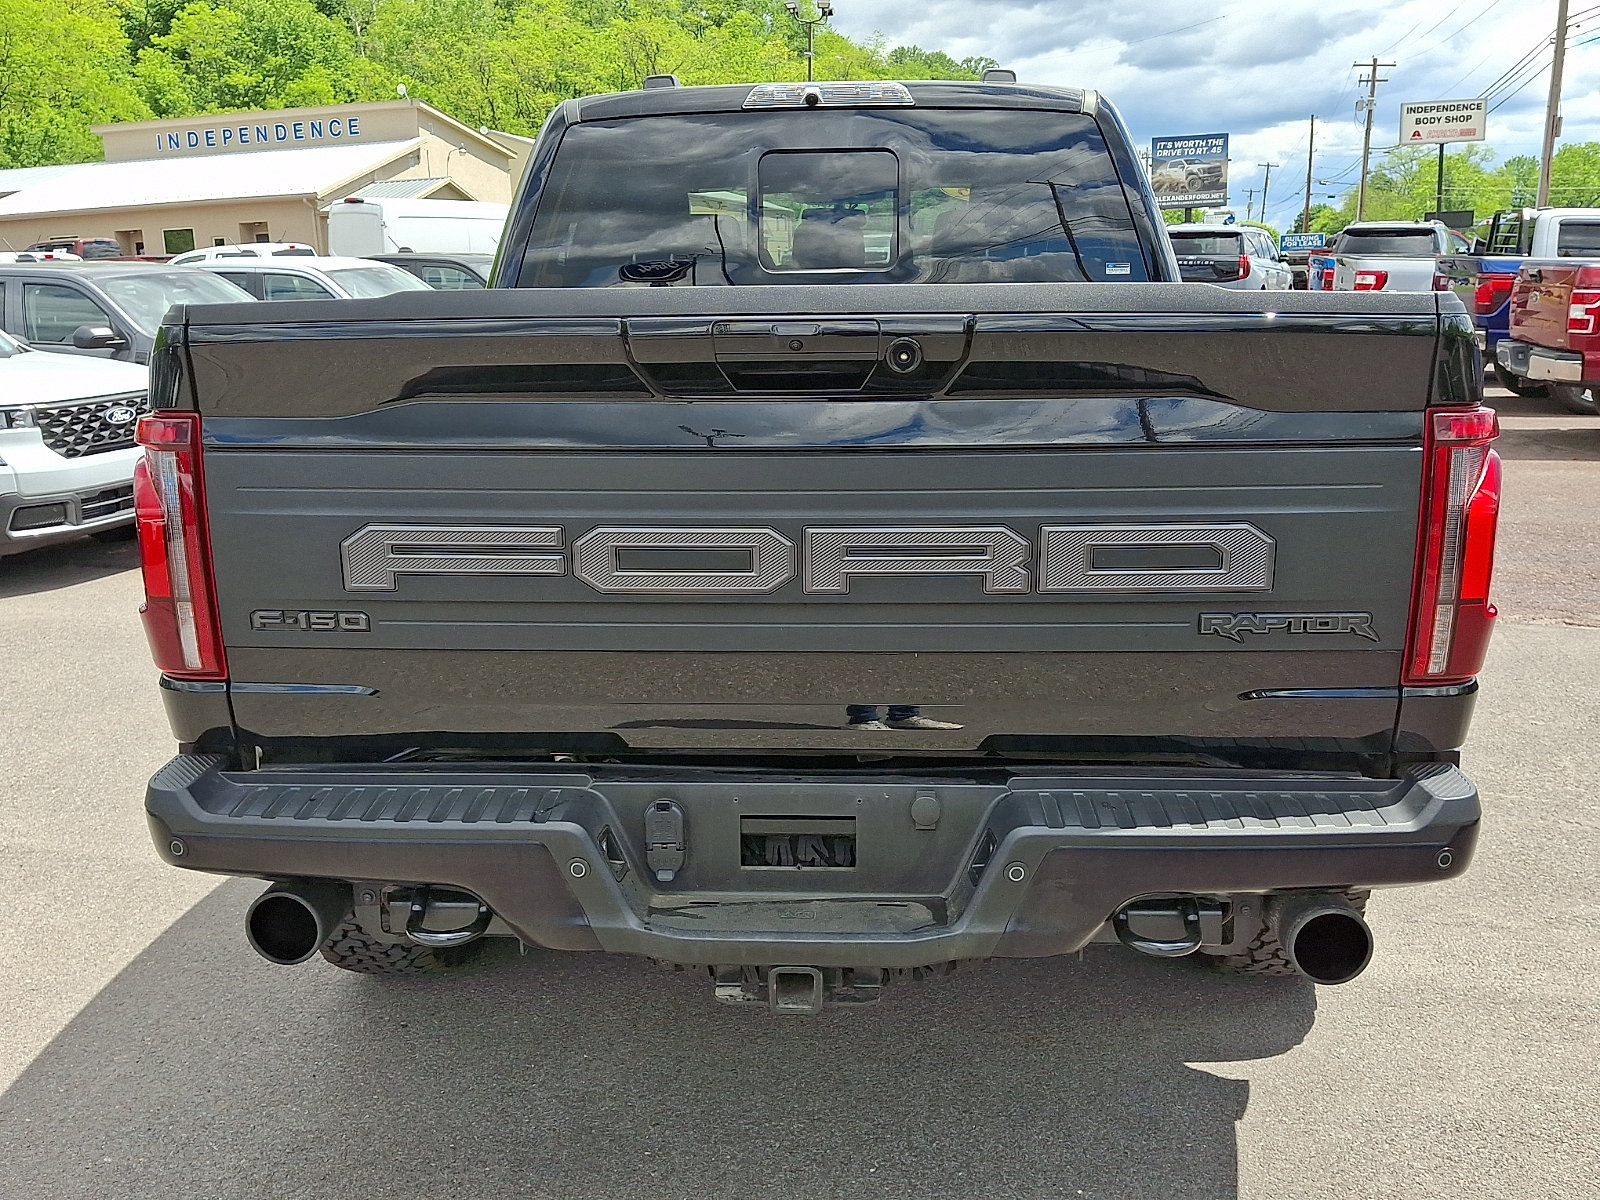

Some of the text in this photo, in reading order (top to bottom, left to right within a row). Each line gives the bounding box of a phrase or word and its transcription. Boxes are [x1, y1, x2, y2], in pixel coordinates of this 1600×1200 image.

[1406, 102, 1482, 114] INDEPENDENCE
[1415, 114, 1472, 125] BODY SHOP
[156, 117, 360, 150] INDEPENDENCE
[1174, 139, 1206, 148] WORTH
[1207, 138, 1224, 146] THE
[1196, 147, 1210, 155] RT.
[340, 523, 1276, 595] FORD
[250, 610, 370, 632] F-150
[1199, 612, 1380, 643] RAPTOR
